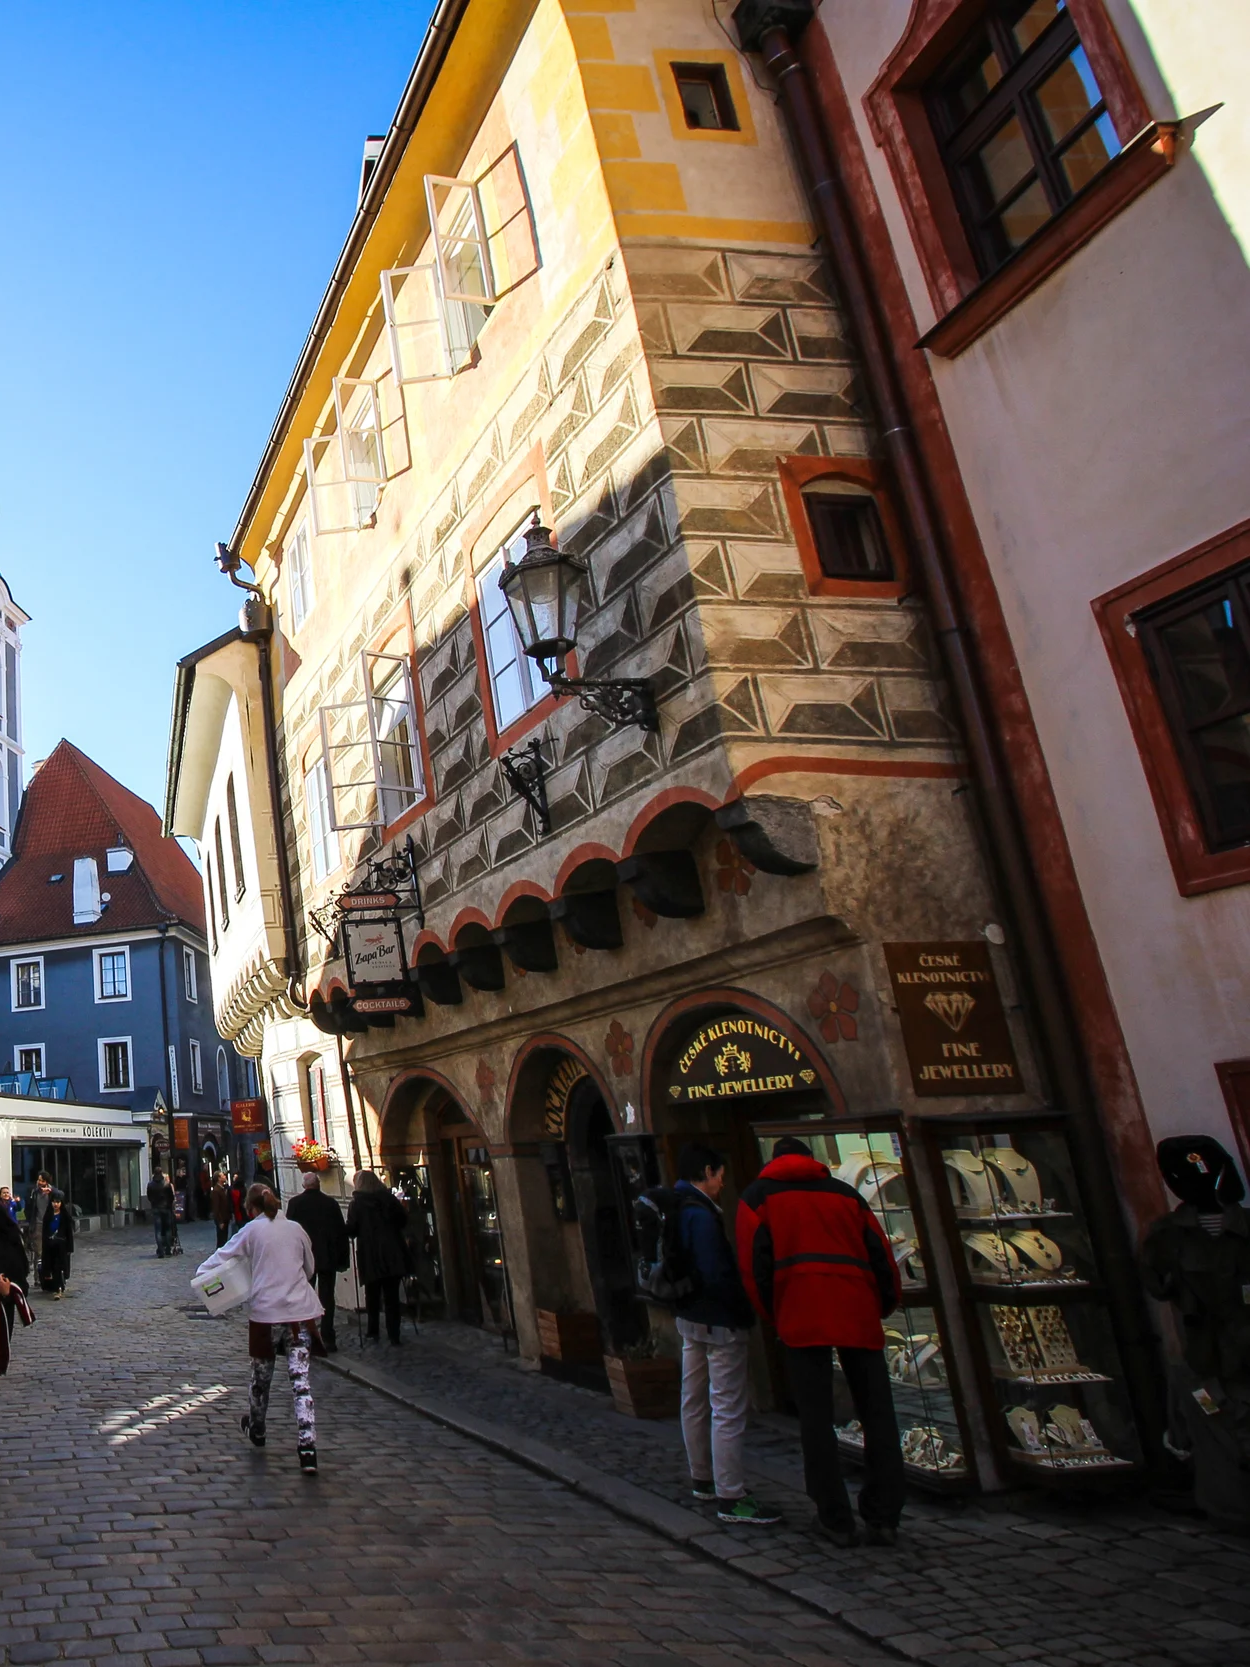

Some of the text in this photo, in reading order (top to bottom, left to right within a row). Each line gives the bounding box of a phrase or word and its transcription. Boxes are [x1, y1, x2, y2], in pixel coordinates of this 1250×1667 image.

[351, 896, 385, 906] DRINKS
[354, 944, 396, 966] Zapa Bar
[356, 999, 406, 1011] COCKTAILS
[941, 1042, 982, 1058] FINE
[919, 1063, 1015, 1080] JEWELLERY
[687, 1074, 795, 1100] FINE JEWELLERY
[82, 1126, 113, 1138] KOLEKTIV
